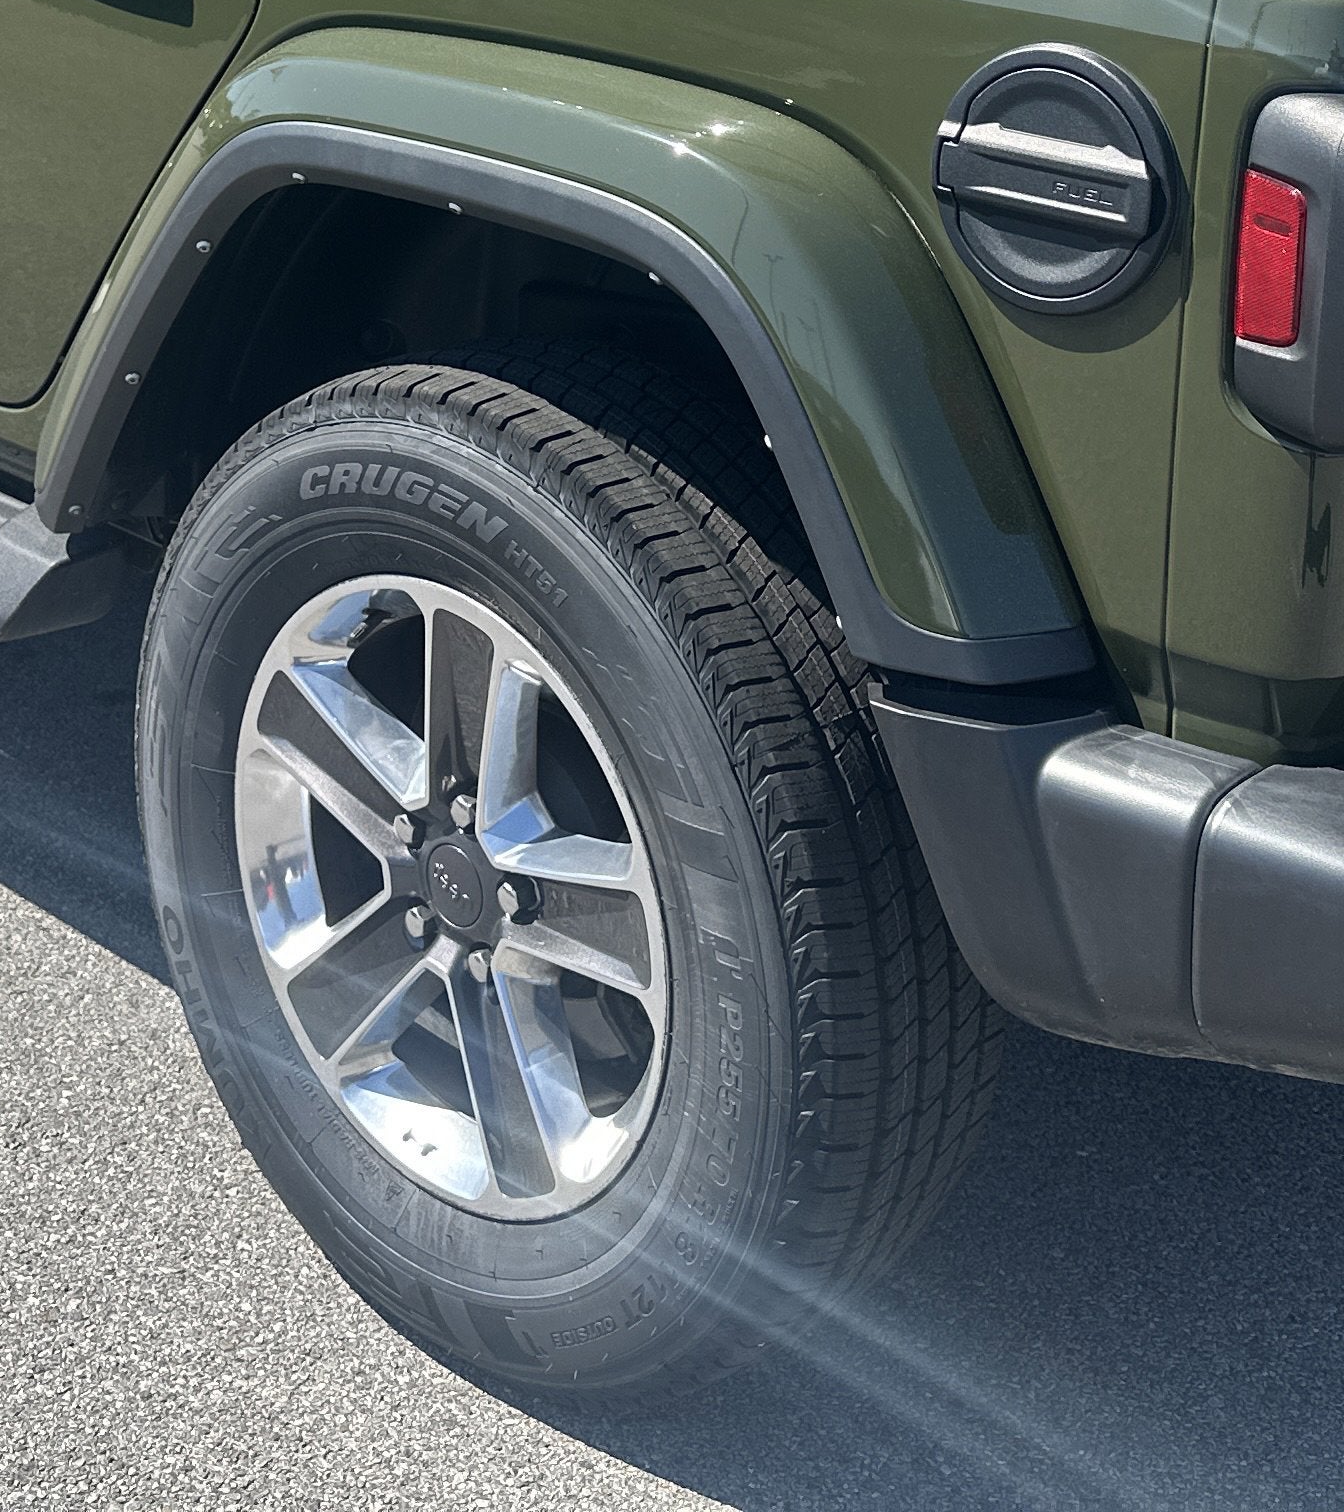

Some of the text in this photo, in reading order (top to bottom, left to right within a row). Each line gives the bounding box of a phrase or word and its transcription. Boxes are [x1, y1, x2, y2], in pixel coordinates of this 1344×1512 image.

[1052, 181, 1113, 206] FUEL
[299, 462, 569, 608] CRUGEN HT51
[551, 1315, 619, 1348] OUTSIDE
